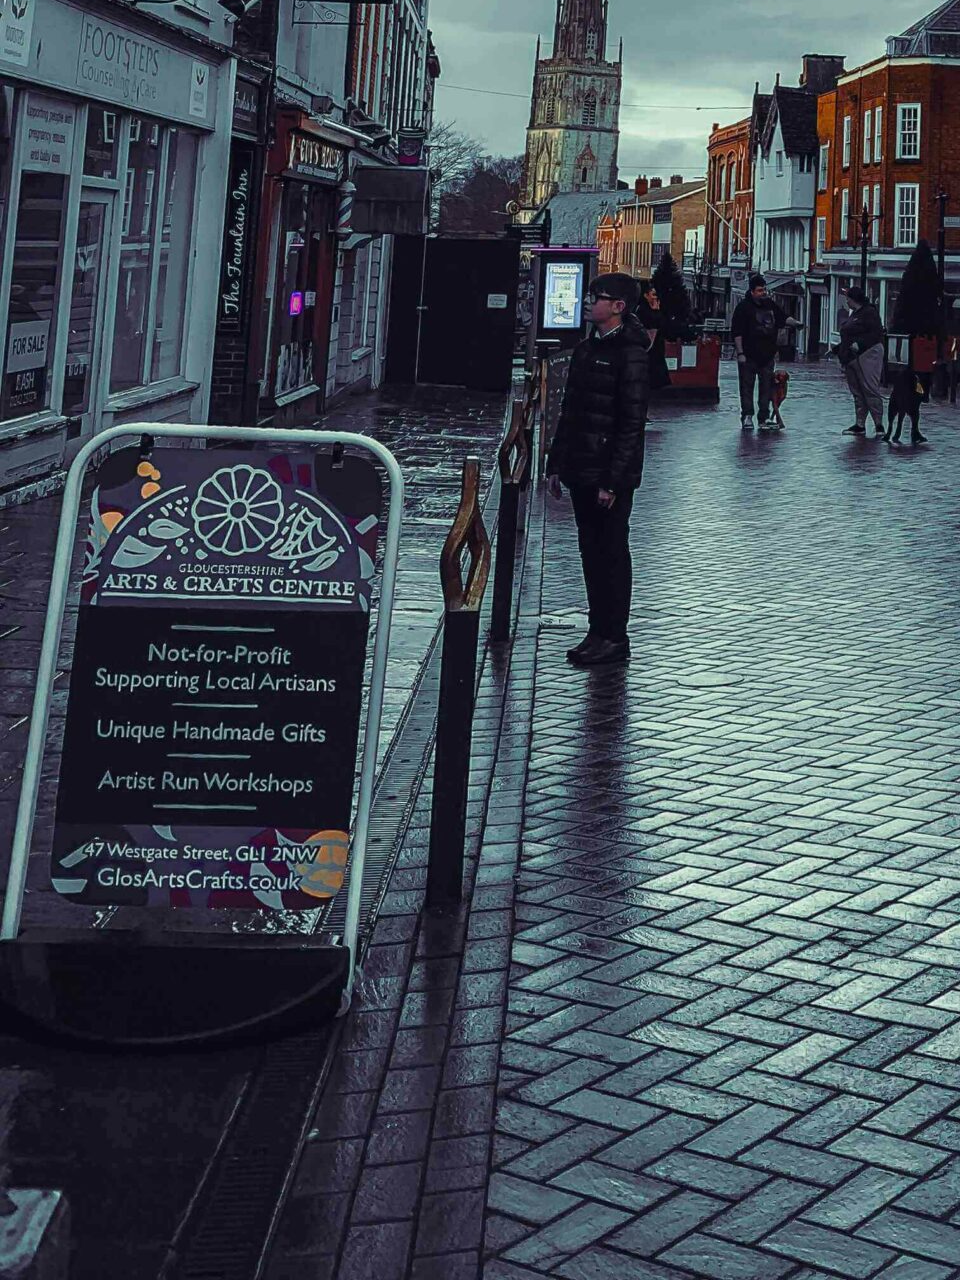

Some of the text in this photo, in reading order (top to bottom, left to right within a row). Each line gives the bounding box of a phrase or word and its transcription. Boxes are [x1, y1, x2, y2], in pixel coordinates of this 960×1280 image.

[83, 22, 160, 77] FOOTSTEPS
[139, 78, 157, 100] Care
[222, 169, 248, 314] The Fountain Inn
[12, 334, 45, 356] FOR SALE
[178, 563, 284, 576] GLOUCESTERSHIRE
[102, 573, 355, 596] ARTS & CRAFTS CENTRE
[148, 643, 292, 665] Not-for-Profit
[95, 668, 336, 693] Supporting Local Artisans
[97, 720, 326, 743] Unique Handmade Gifts
[98, 770, 313, 797] Artist Run Workshops
[85, 842, 103, 857] 47
[107, 842, 178, 863] Westgate
[183, 845, 233, 861] Street,
[272, 847, 318, 863] 2NW
[97, 867, 301, 891] GlosArtsCrafts.co.uk
